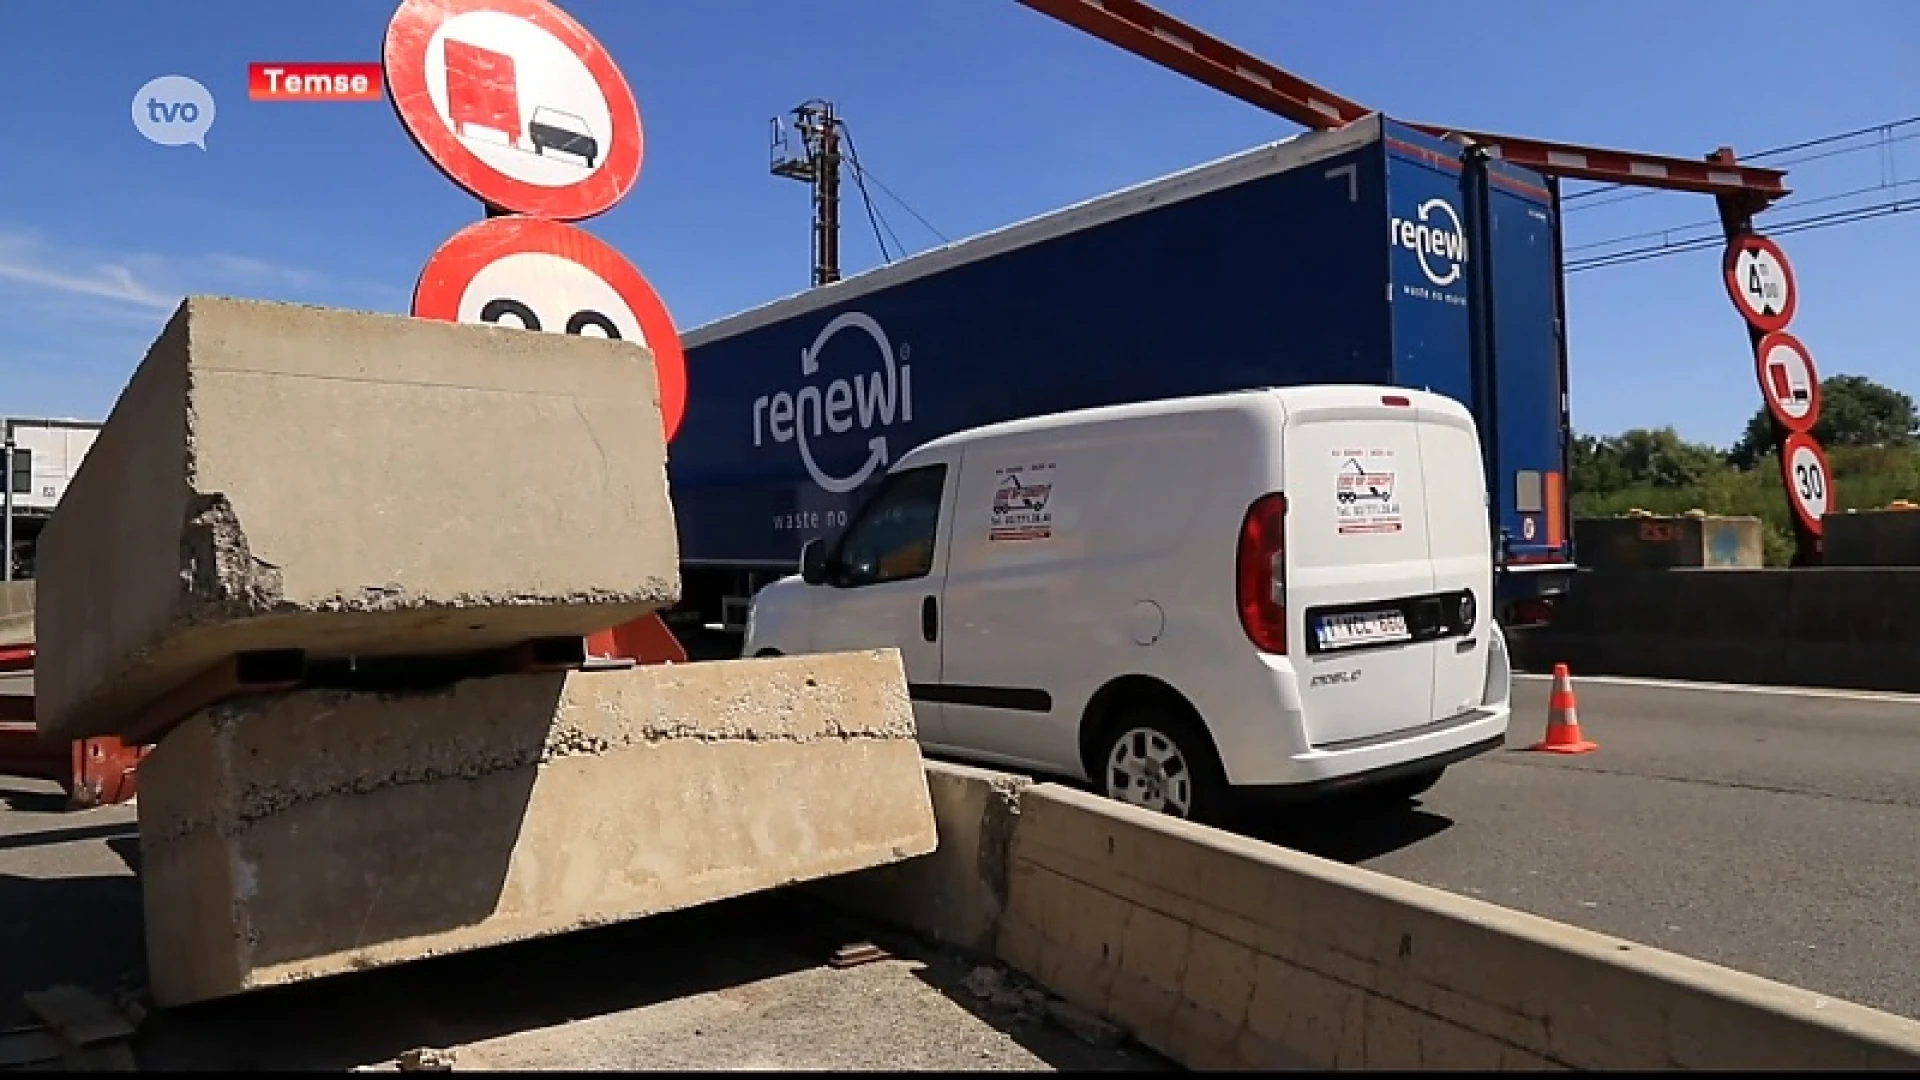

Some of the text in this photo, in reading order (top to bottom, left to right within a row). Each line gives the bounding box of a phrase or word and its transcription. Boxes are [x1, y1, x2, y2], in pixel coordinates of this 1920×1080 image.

[753, 364, 912, 446] renewi
[1796, 464, 1823, 499] 30
[773, 510, 847, 529] waste no
